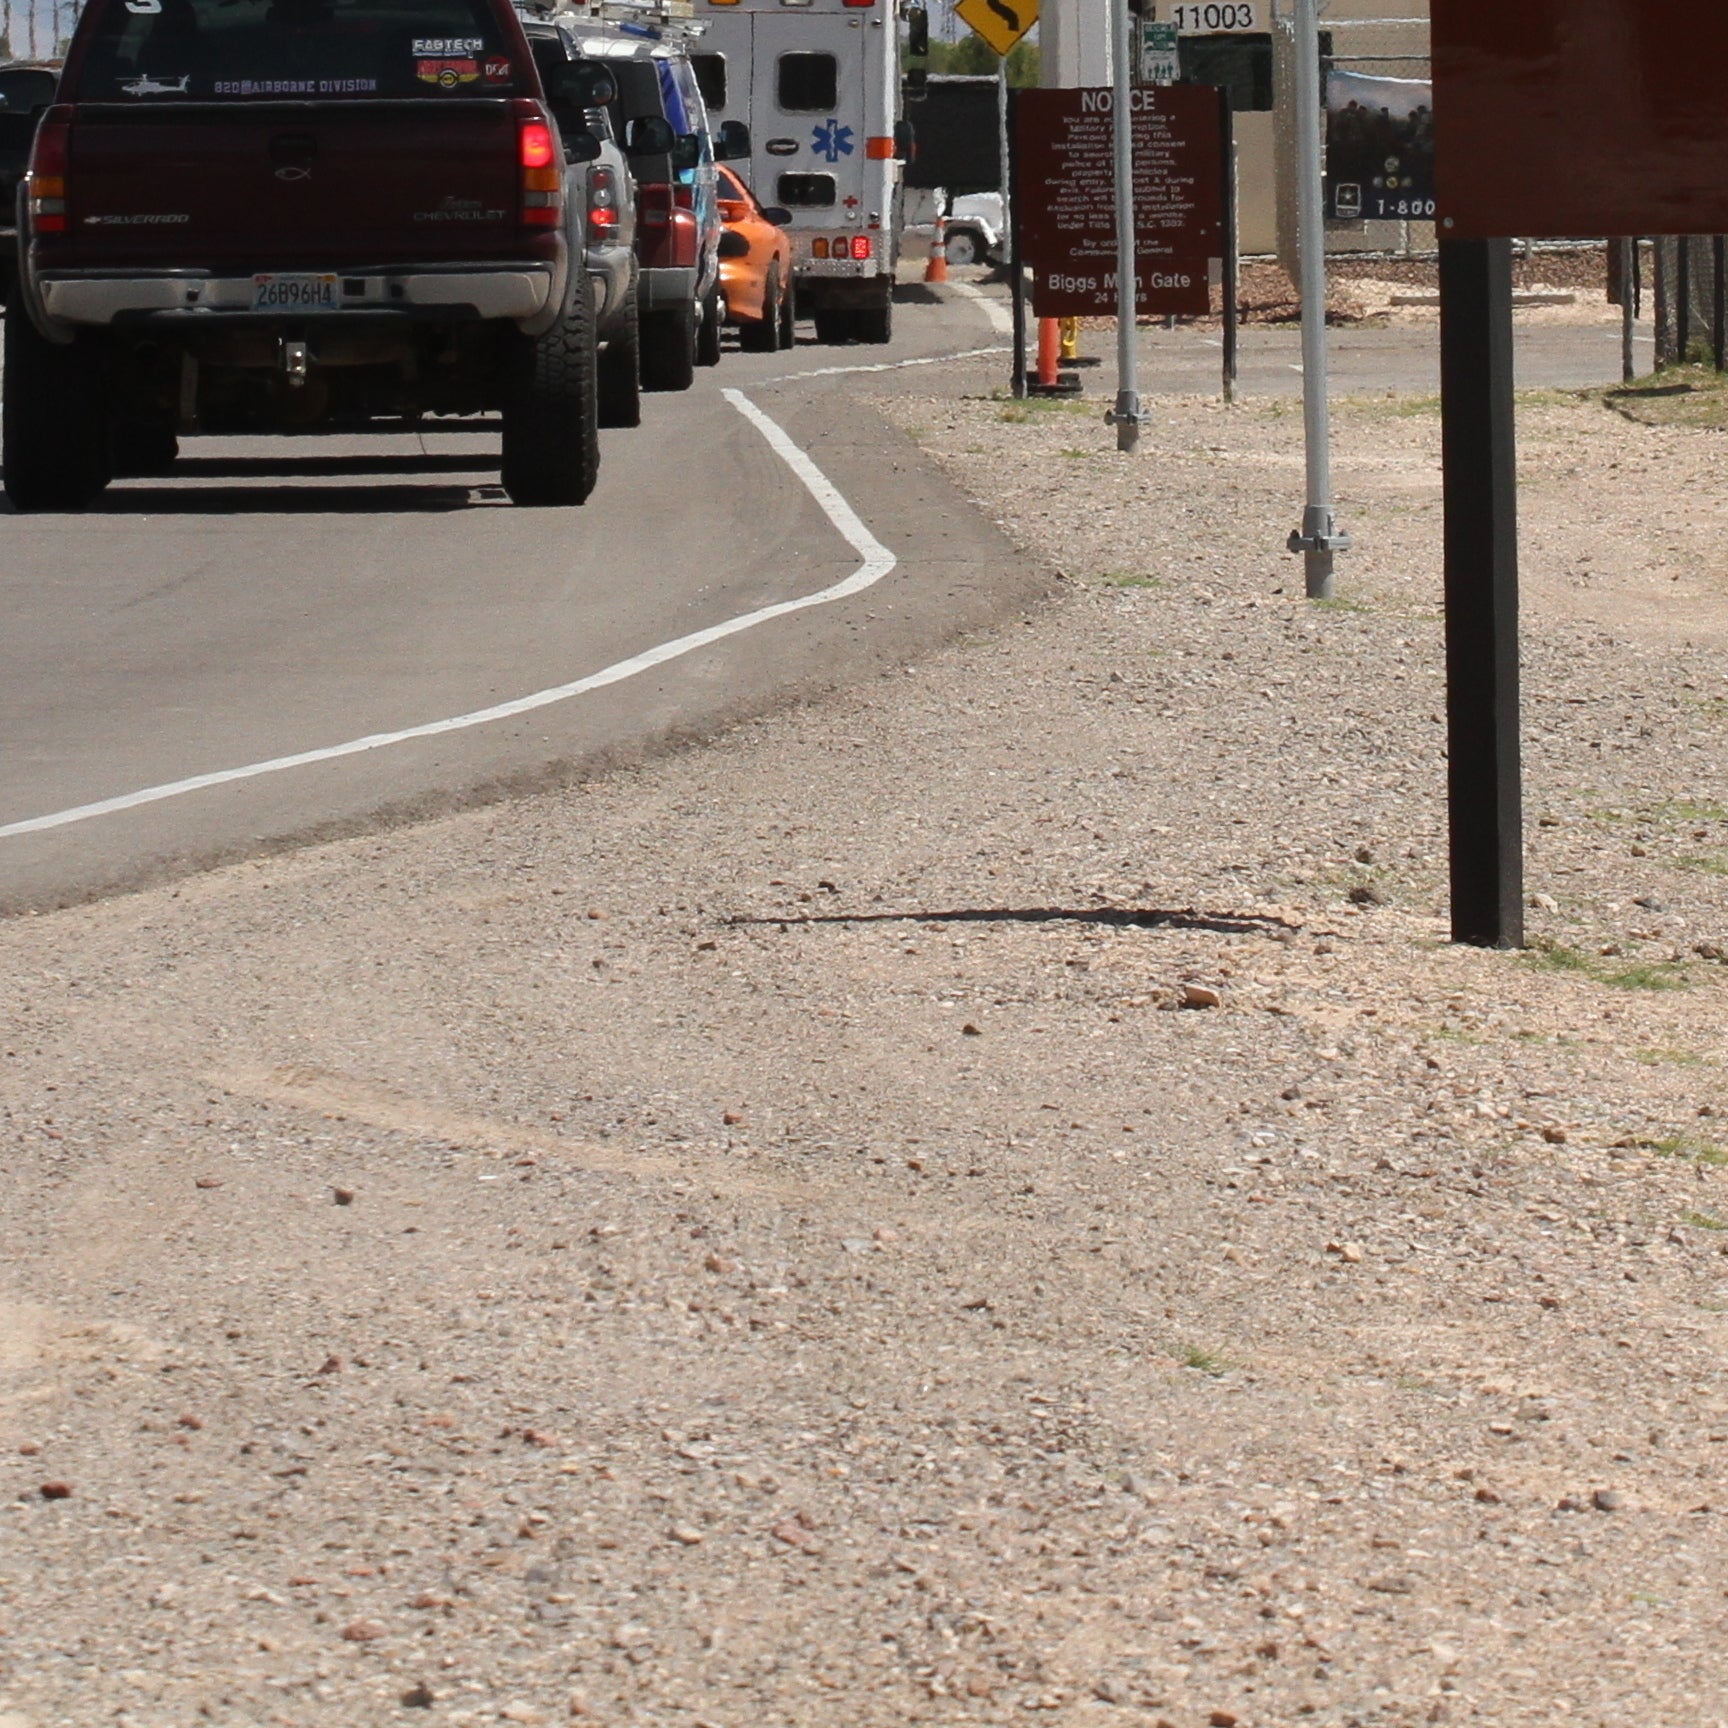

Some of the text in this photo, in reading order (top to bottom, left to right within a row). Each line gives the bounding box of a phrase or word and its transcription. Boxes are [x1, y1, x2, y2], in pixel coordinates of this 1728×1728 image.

[1174, 3, 1253, 30] 11003
[413, 38, 482, 51] FABTECH
[251, 80, 315, 93] AIRBORNE
[319, 79, 376, 92] DIVISION
[1081, 89, 1156, 113] NOCE
[102, 214, 190, 224] SILVERADO
[414, 209, 506, 221] CHEVROLET
[1048, 271, 1192, 293] Biggs Mn Gate
[1093, 291, 1148, 304] 24 Hrs
